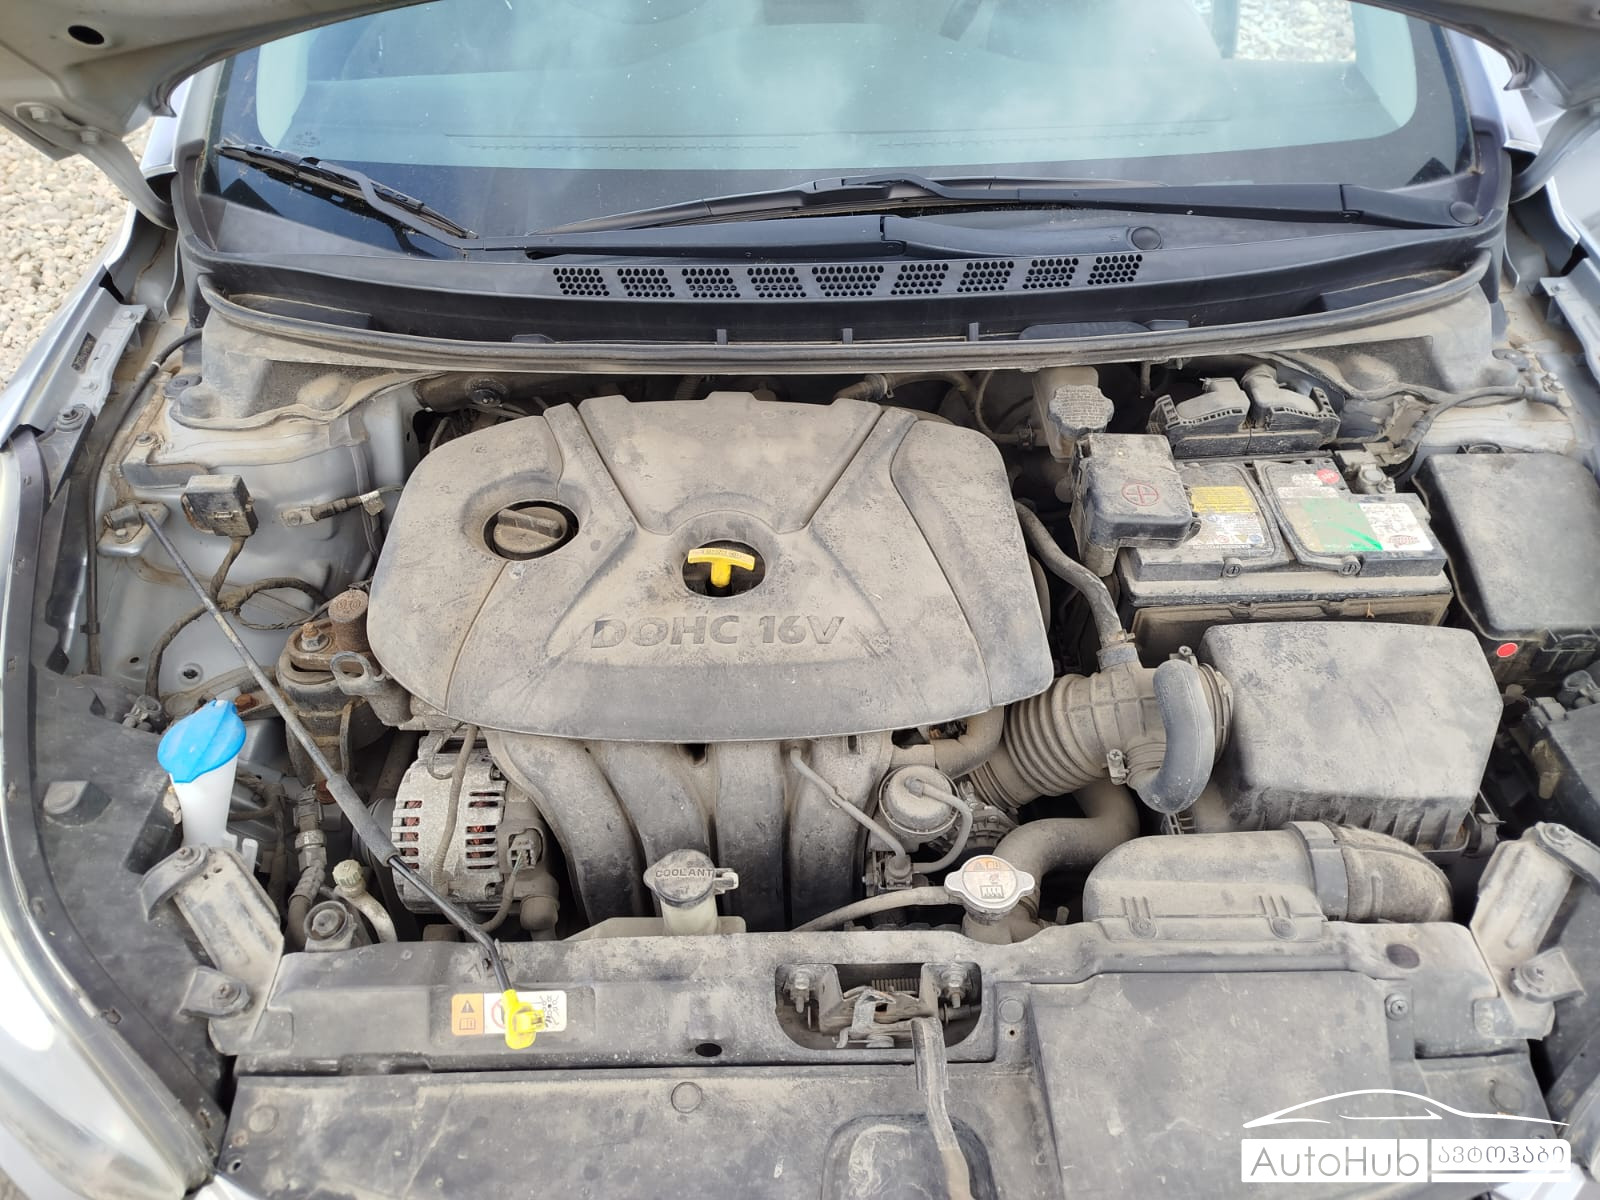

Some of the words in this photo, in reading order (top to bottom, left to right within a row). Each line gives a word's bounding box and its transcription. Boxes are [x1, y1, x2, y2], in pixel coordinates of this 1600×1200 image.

[591, 615, 740, 648] DOHC
[759, 615, 845, 645] 16V
[655, 868, 713, 878] COOLANT
